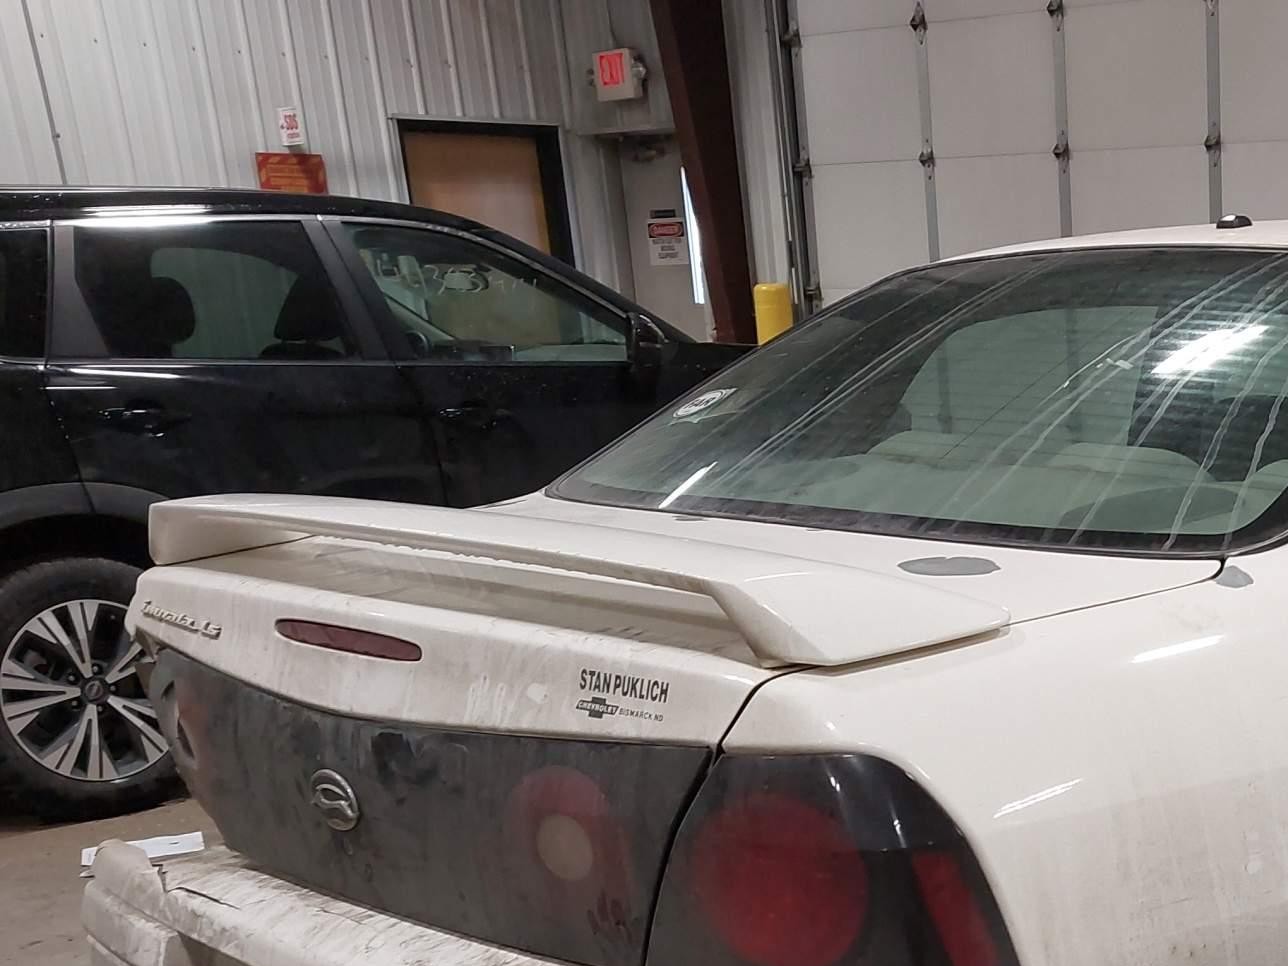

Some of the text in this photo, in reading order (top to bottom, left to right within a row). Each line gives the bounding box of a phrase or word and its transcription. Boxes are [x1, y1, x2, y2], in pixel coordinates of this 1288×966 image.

[580, 668, 670, 704] STAN PUKLICH
[578, 701, 664, 722] CHEVROLET BISMARCK ND
